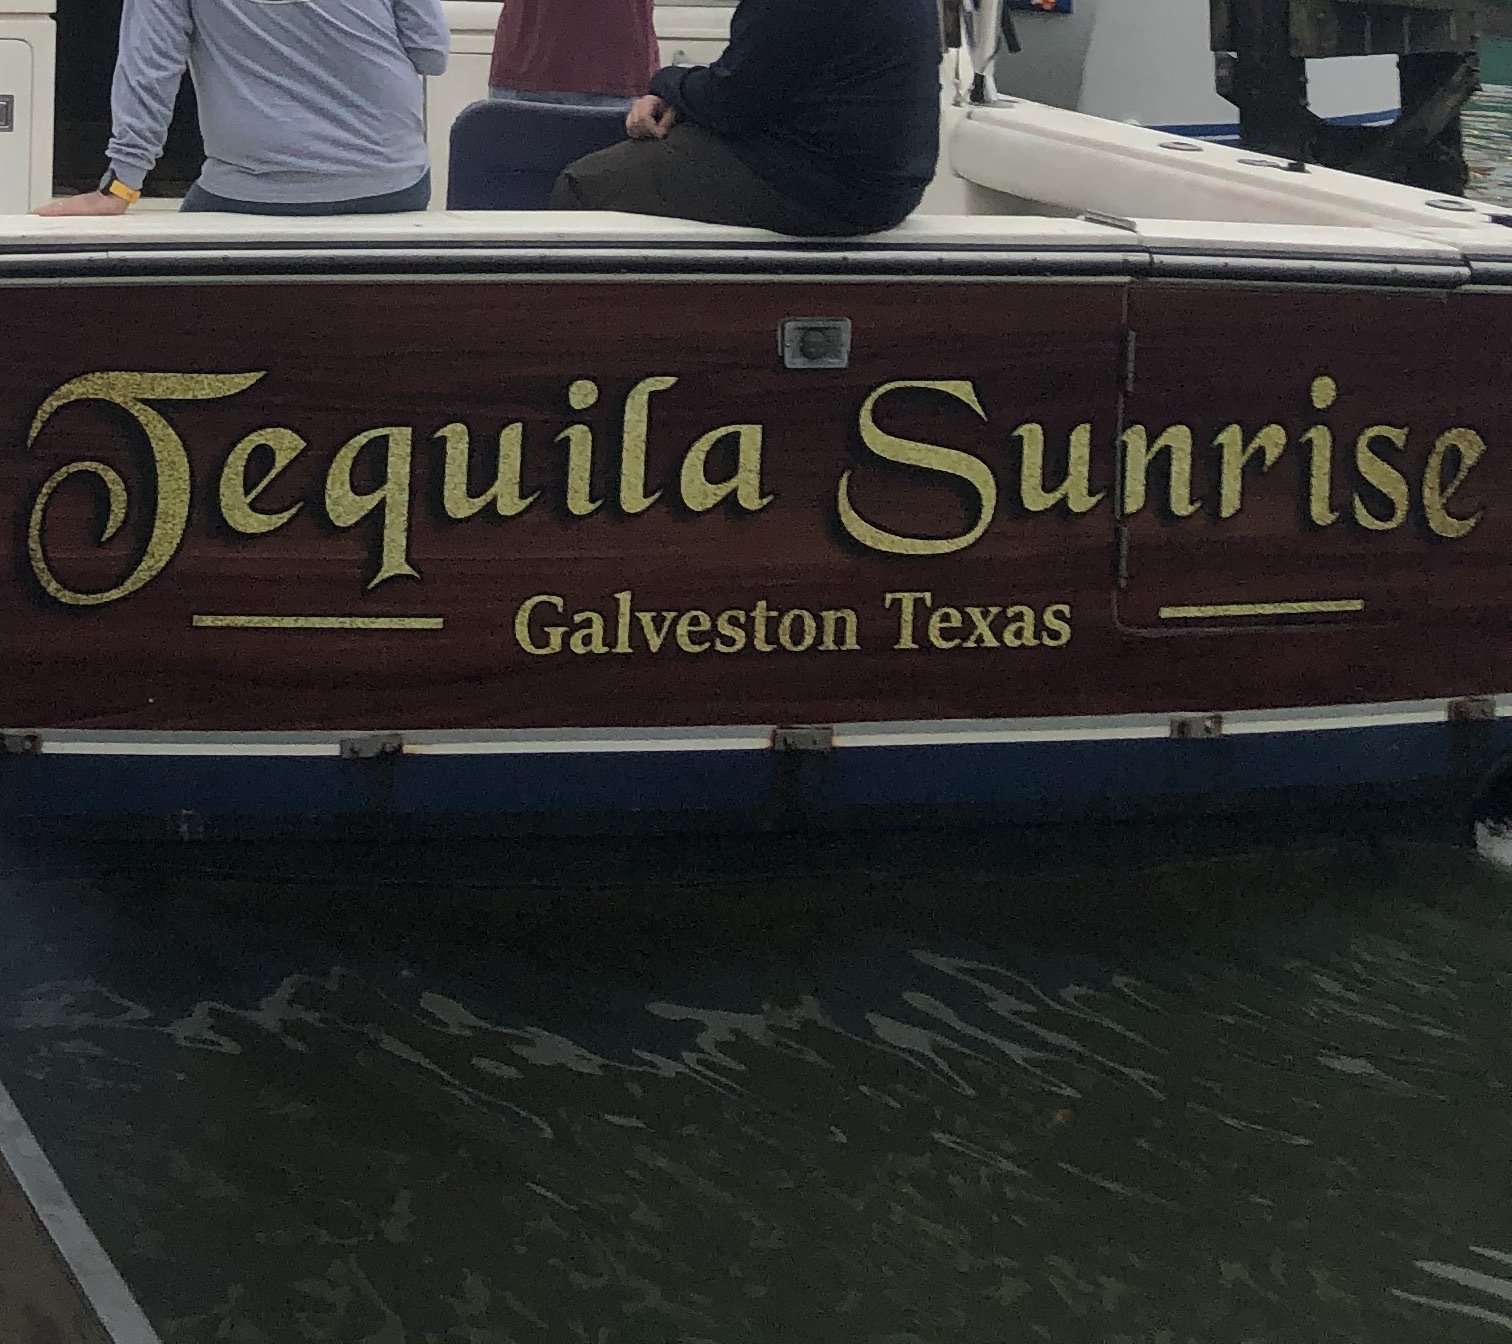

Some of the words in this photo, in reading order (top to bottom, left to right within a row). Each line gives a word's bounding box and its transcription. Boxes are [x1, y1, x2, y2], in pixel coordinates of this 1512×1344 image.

[26, 371, 773, 605] Tequila
[837, 376, 1487, 555] Sunrise
[514, 590, 861, 656] Galveston
[883, 590, 1074, 652] Texas
